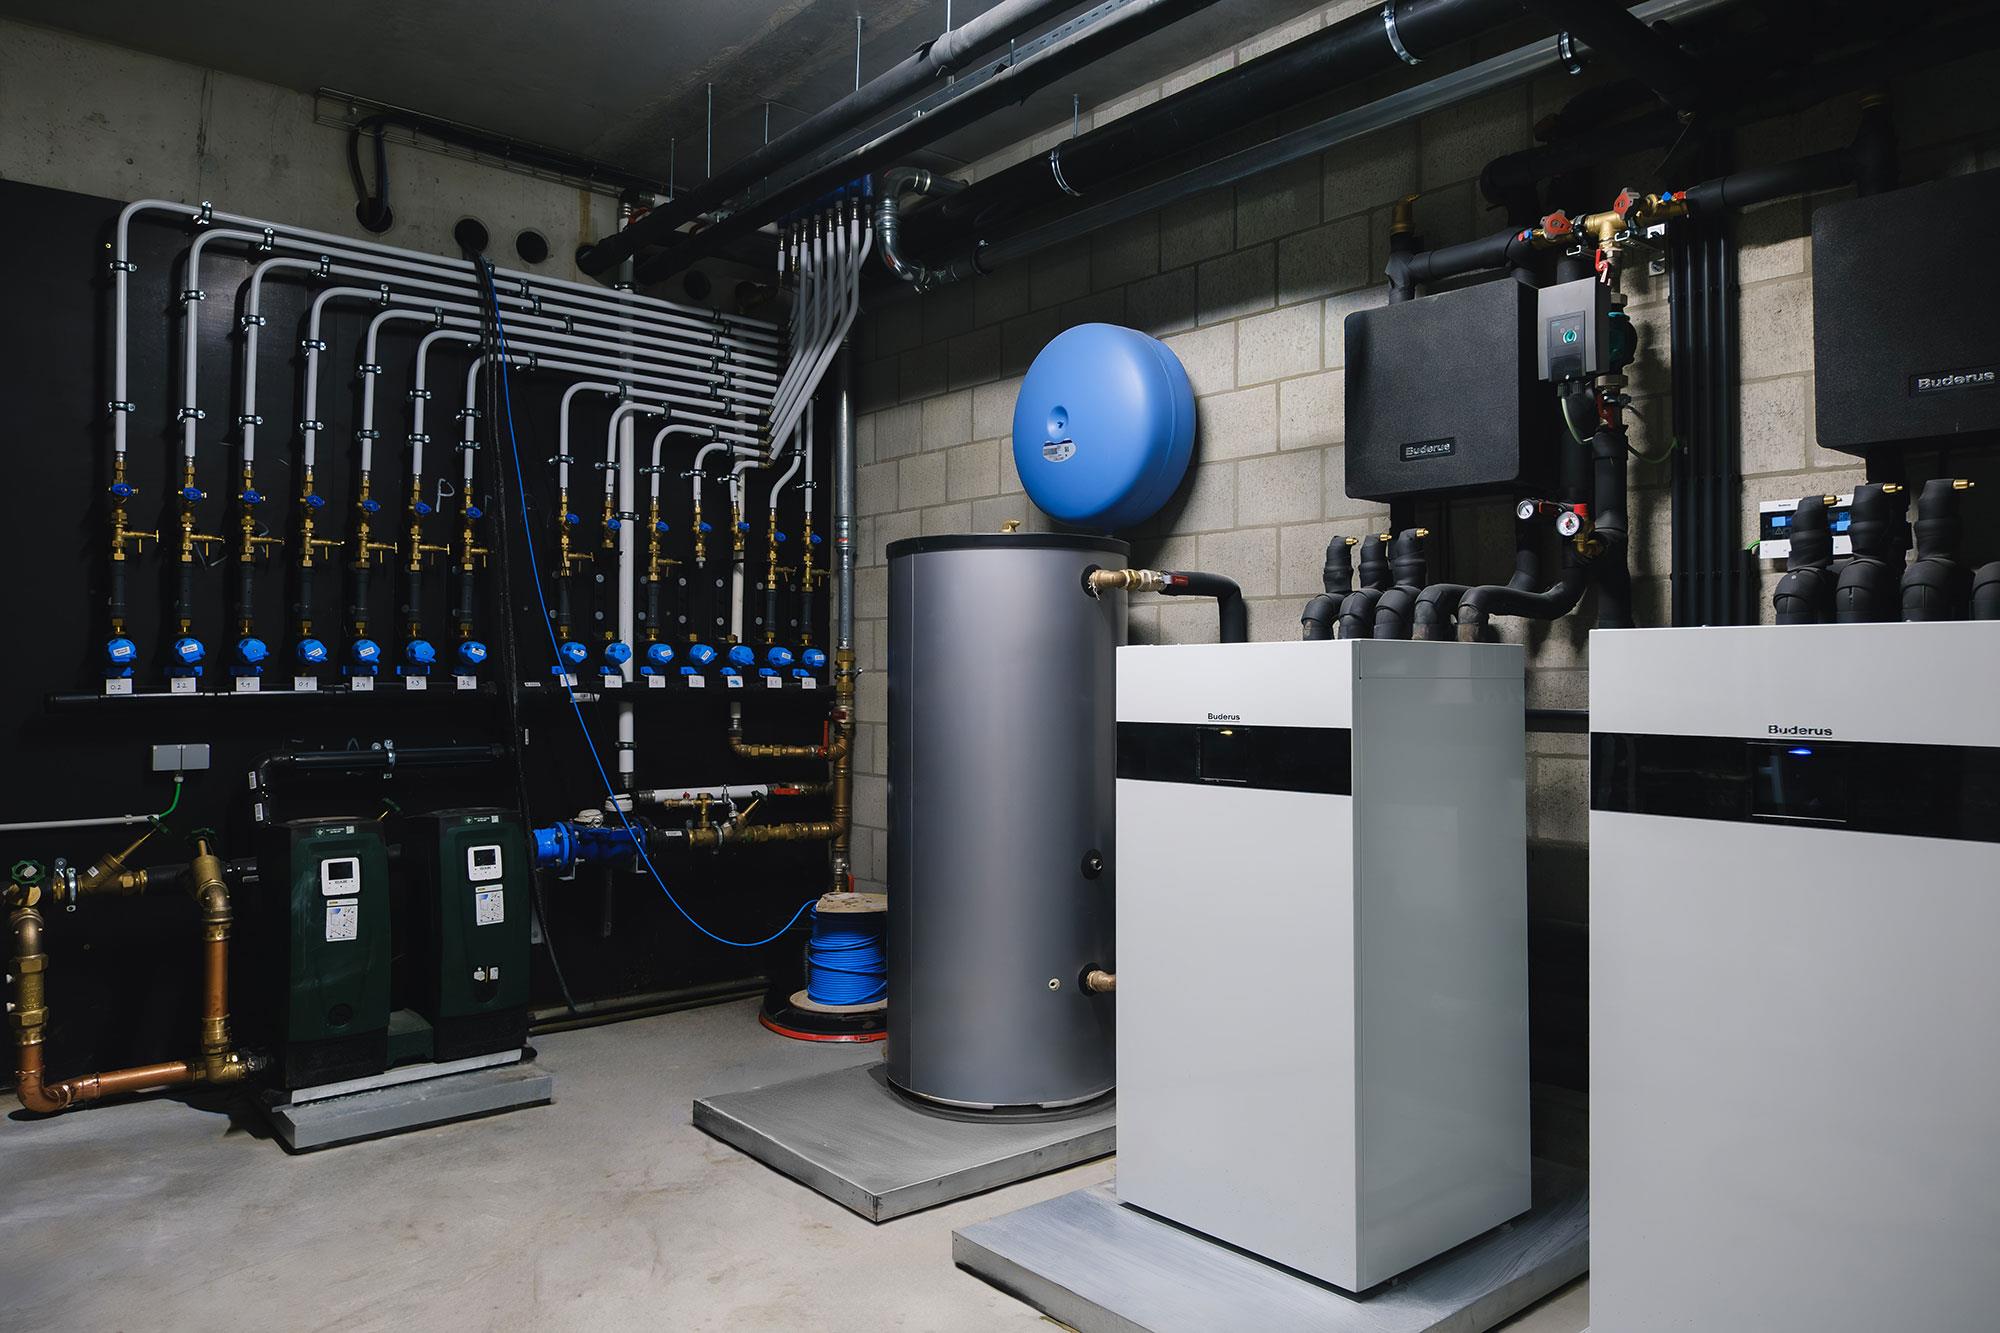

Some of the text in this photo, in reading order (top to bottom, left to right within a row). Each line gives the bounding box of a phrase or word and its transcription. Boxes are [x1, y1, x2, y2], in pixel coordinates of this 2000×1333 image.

[1918, 371, 1996, 390] Buderus
[1405, 443, 1450, 456] Buderus
[1207, 712, 1241, 721] Buderus
[1767, 724, 1833, 737] Buderus
